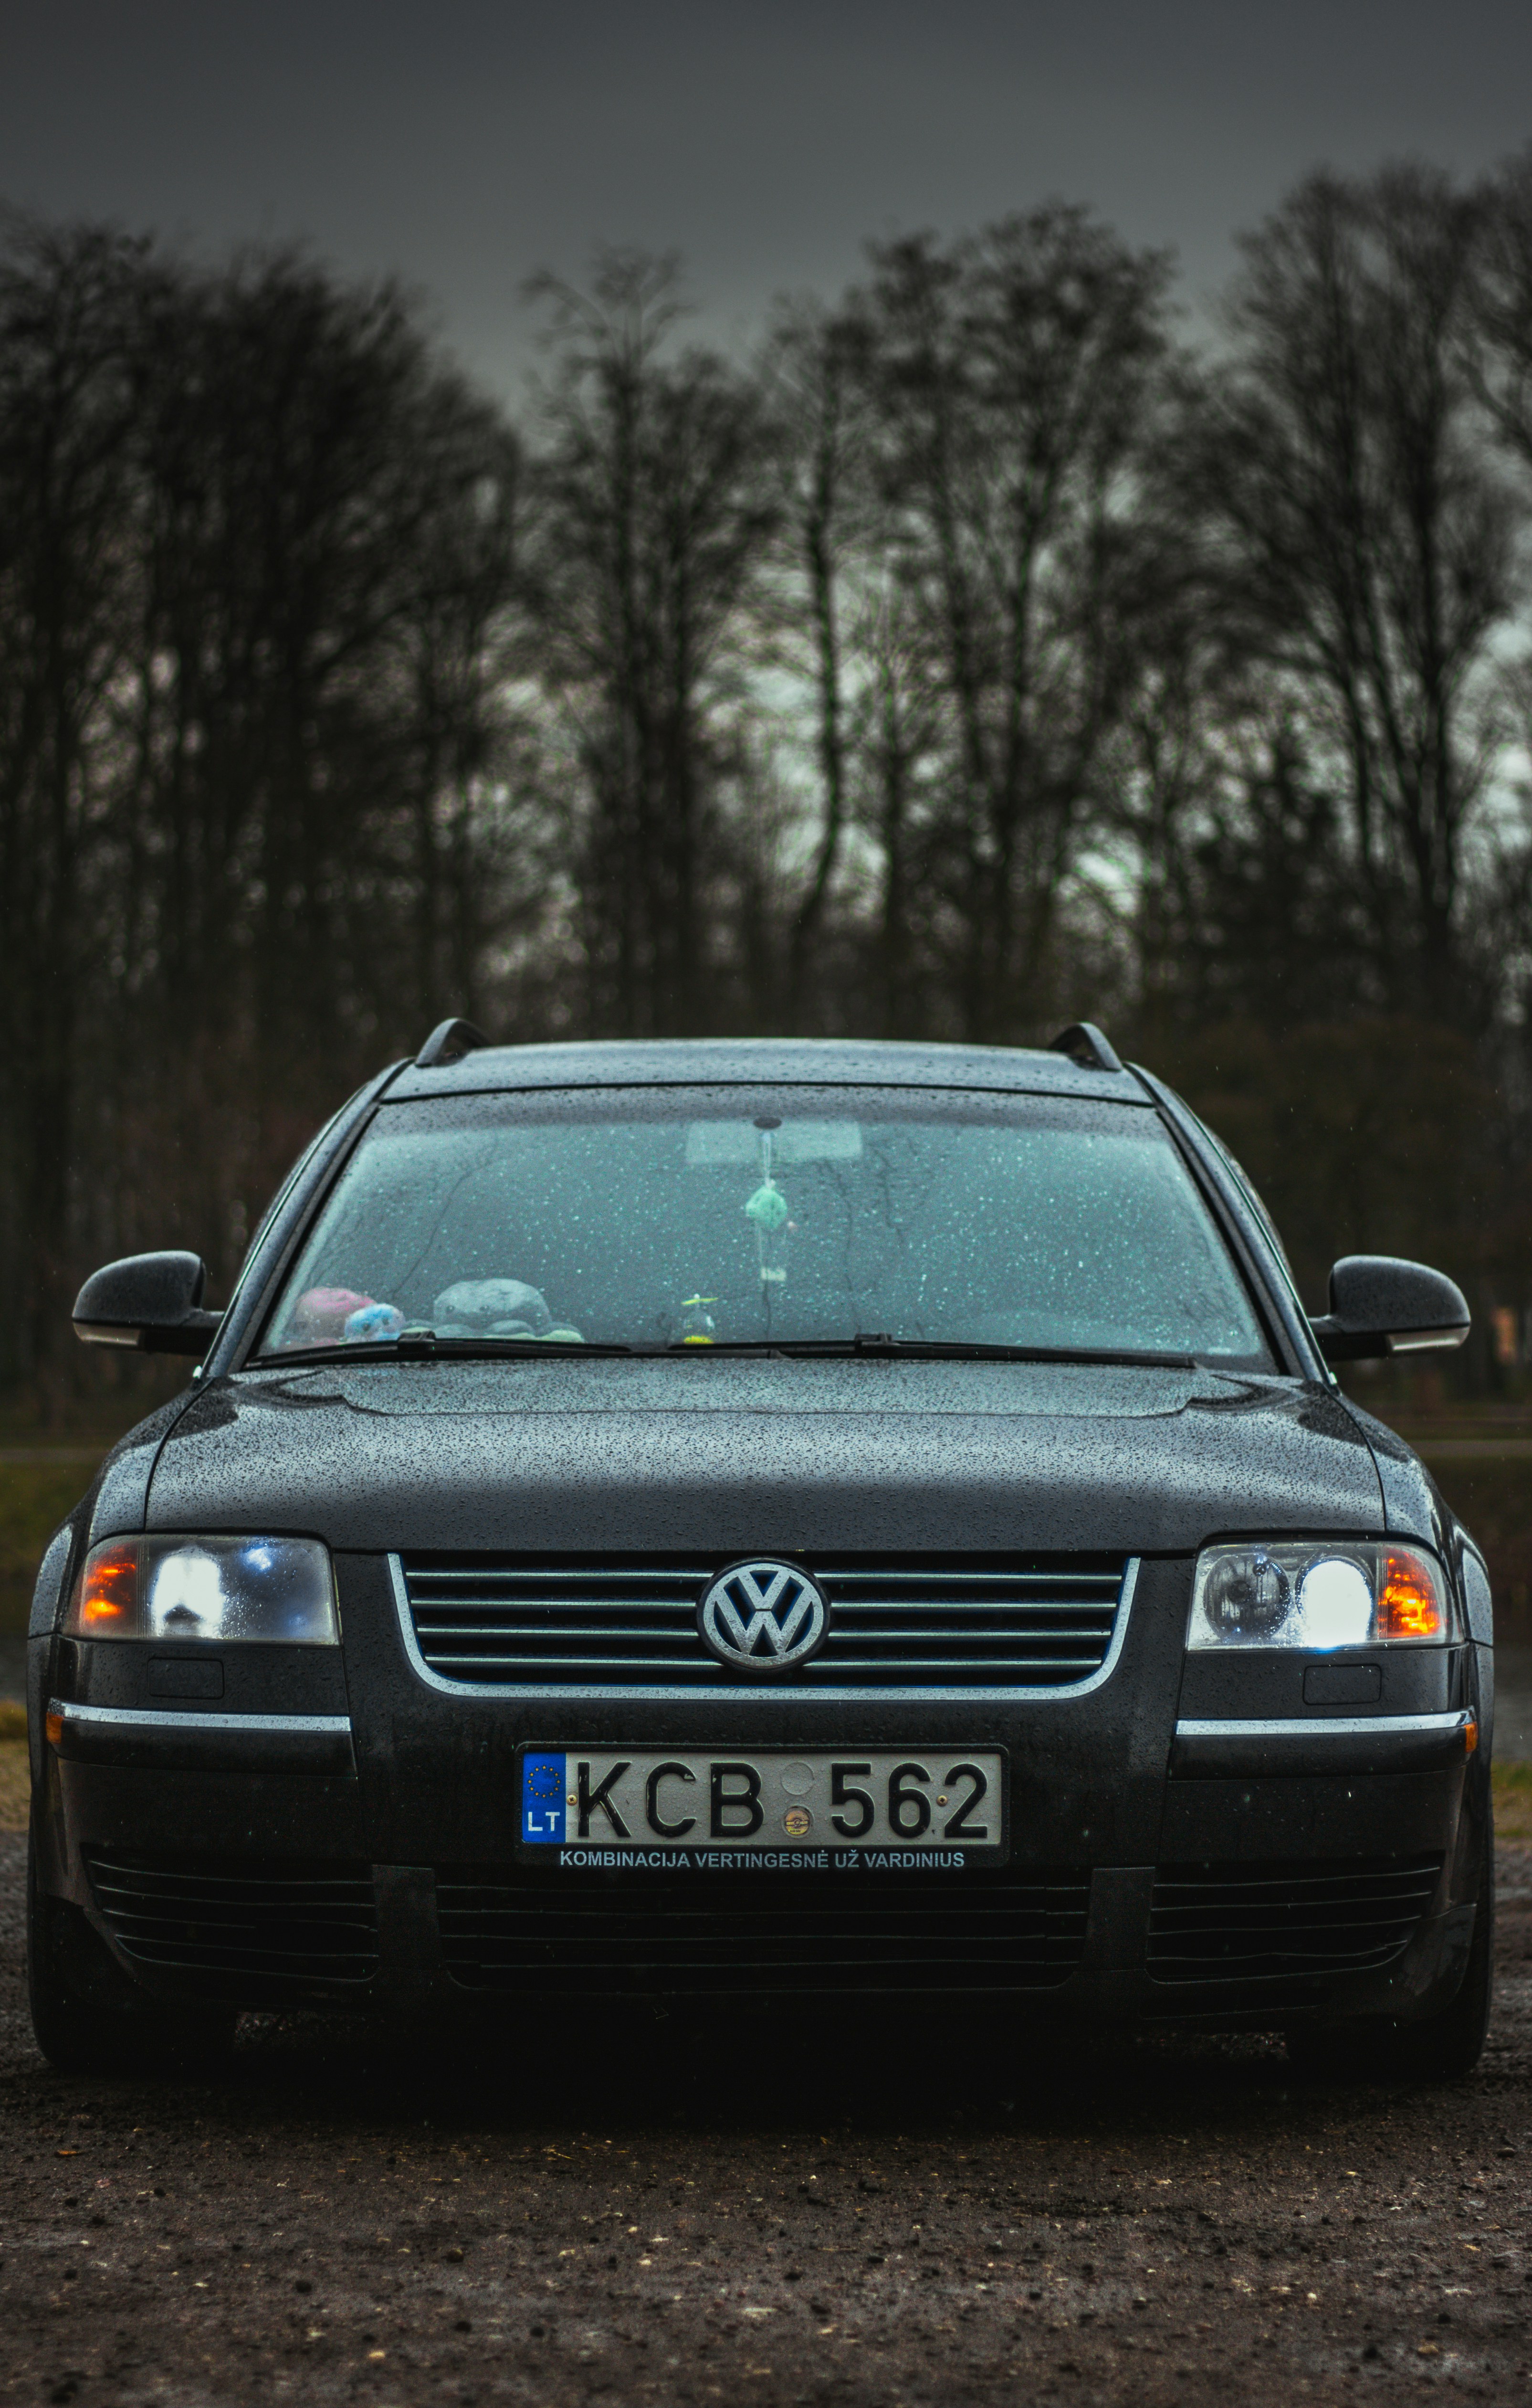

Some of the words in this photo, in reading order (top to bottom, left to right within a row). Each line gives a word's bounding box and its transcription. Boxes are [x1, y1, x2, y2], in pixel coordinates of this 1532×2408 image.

[703, 1563, 824, 1666] VW
[527, 1811, 560, 1832] LT
[577, 1762, 764, 1838] KCB
[831, 1763, 988, 1838] 562
[560, 1850, 691, 1868] KOMBINACIJA
[694, 1849, 829, 1868] VERTINGESNĖ
[835, 1849, 860, 1868] UŽ
[863, 1852, 965, 1868] VARDINIUS
